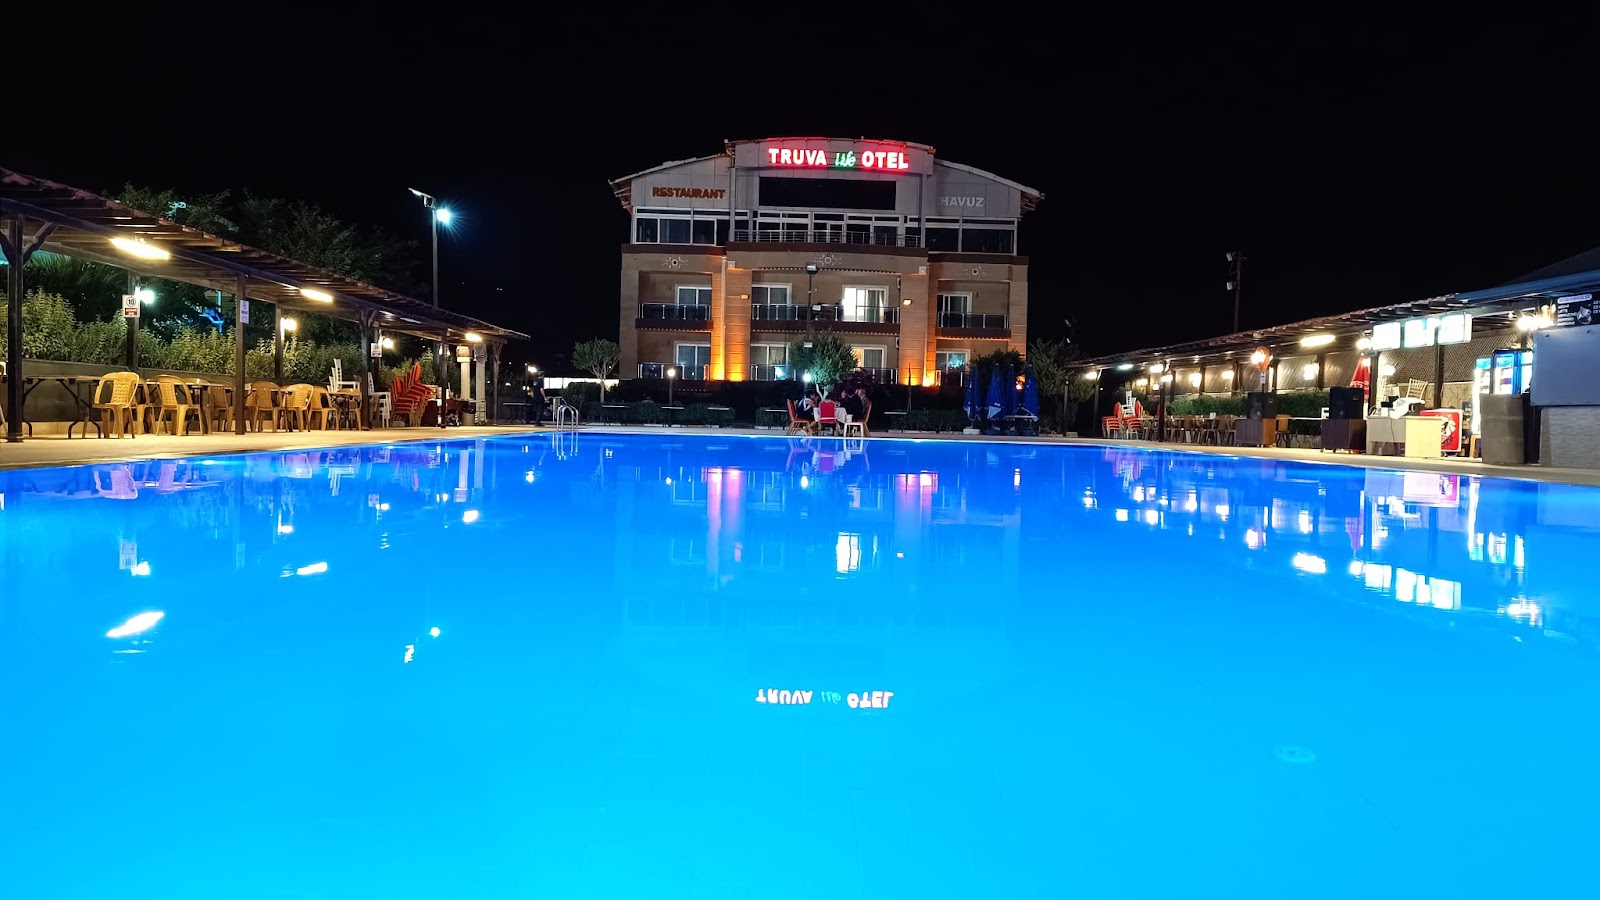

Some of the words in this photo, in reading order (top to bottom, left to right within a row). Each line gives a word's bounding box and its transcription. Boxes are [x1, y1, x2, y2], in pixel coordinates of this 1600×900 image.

[768, 148, 827, 166] TRUVA
[861, 150, 909, 170] OTEL
[652, 187, 726, 199] RESTAURANT
[940, 196, 985, 207] HAVUZ
